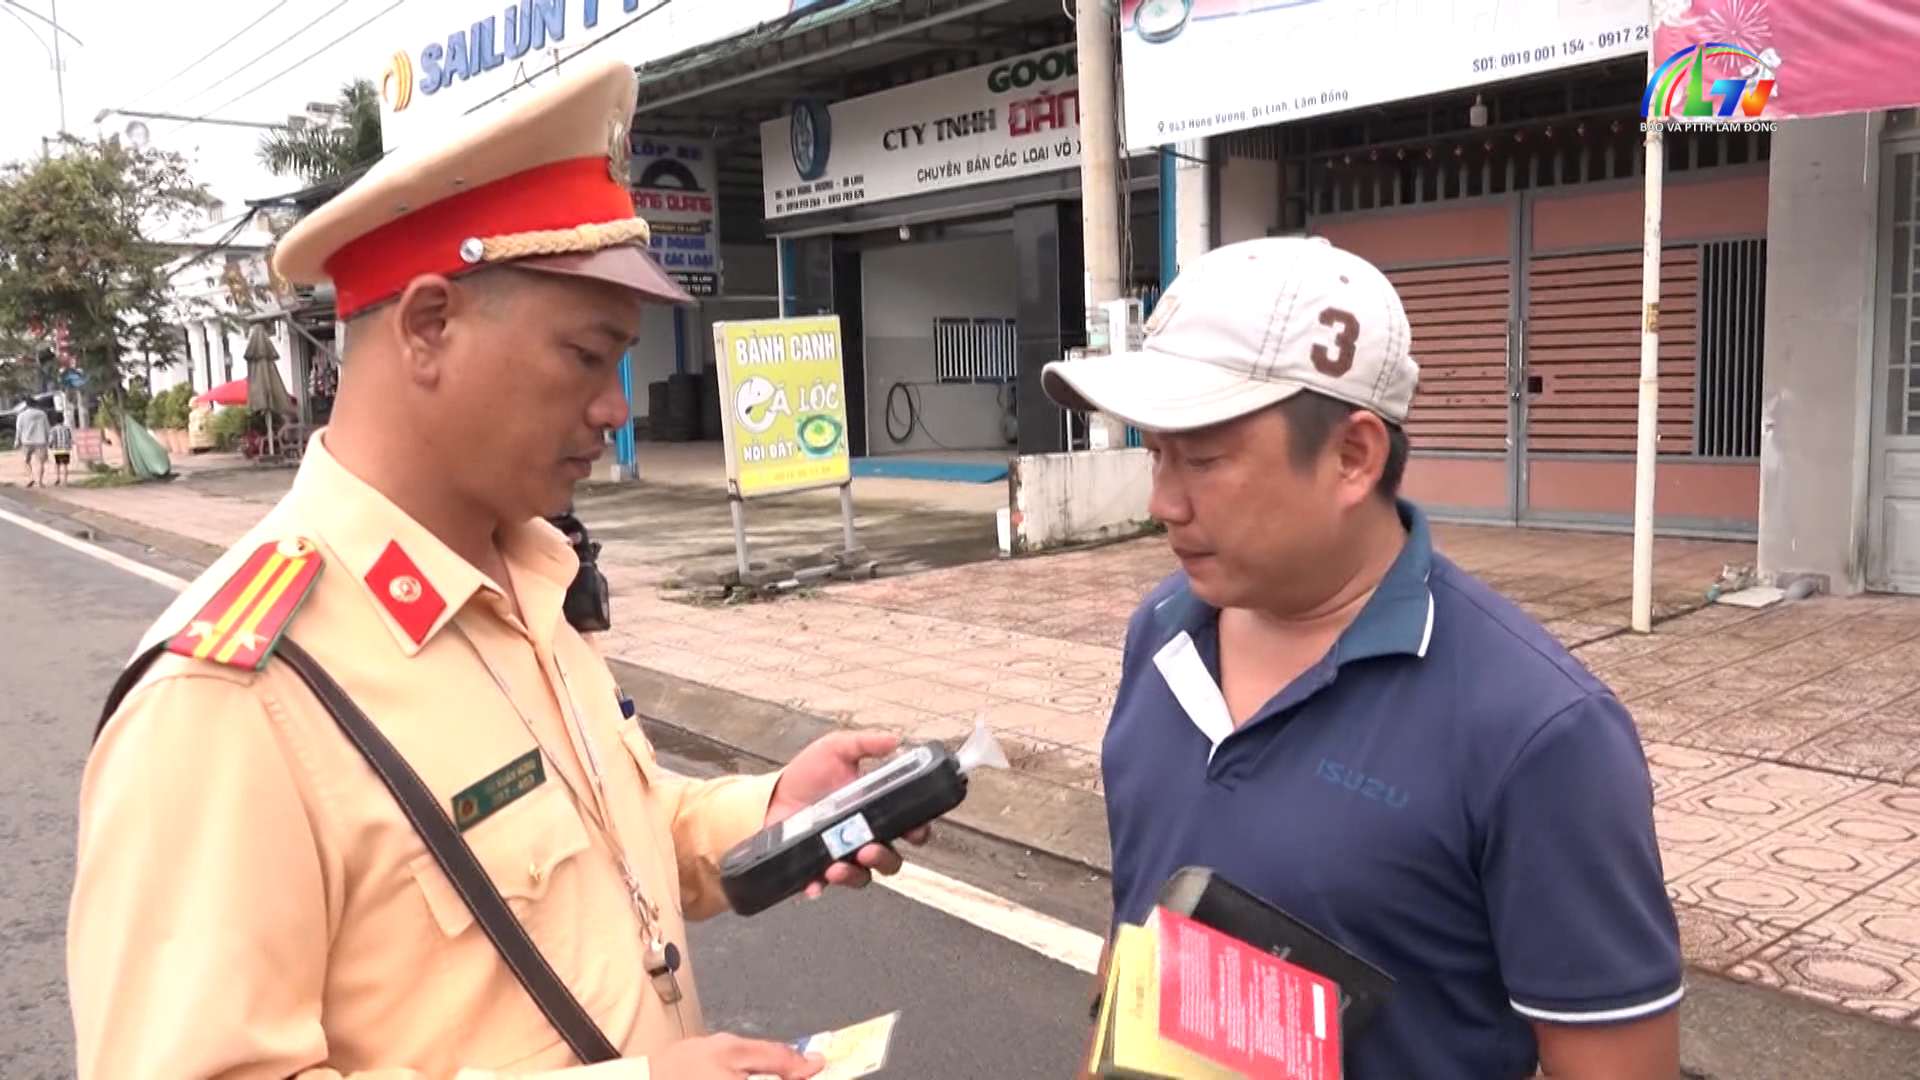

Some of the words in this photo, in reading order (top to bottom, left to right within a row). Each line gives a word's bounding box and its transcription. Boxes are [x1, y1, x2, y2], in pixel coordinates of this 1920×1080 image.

[419, 0, 565, 95] SAILUN
[1534, 45, 1556, 62] 001
[1562, 38, 1585, 56] 154
[1598, 28, 1631, 49] 0917
[883, 123, 926, 151] CTY
[933, 108, 998, 141] TNHH
[917, 160, 961, 183] CHUYÊN
[966, 153, 991, 174] BÁN
[994, 149, 1018, 168] CÁC
[735, 329, 785, 366] BÁNH
[790, 331, 836, 361] CANH
[1311, 306, 1360, 378] 3
[1316, 758, 1410, 809] ISUZU
